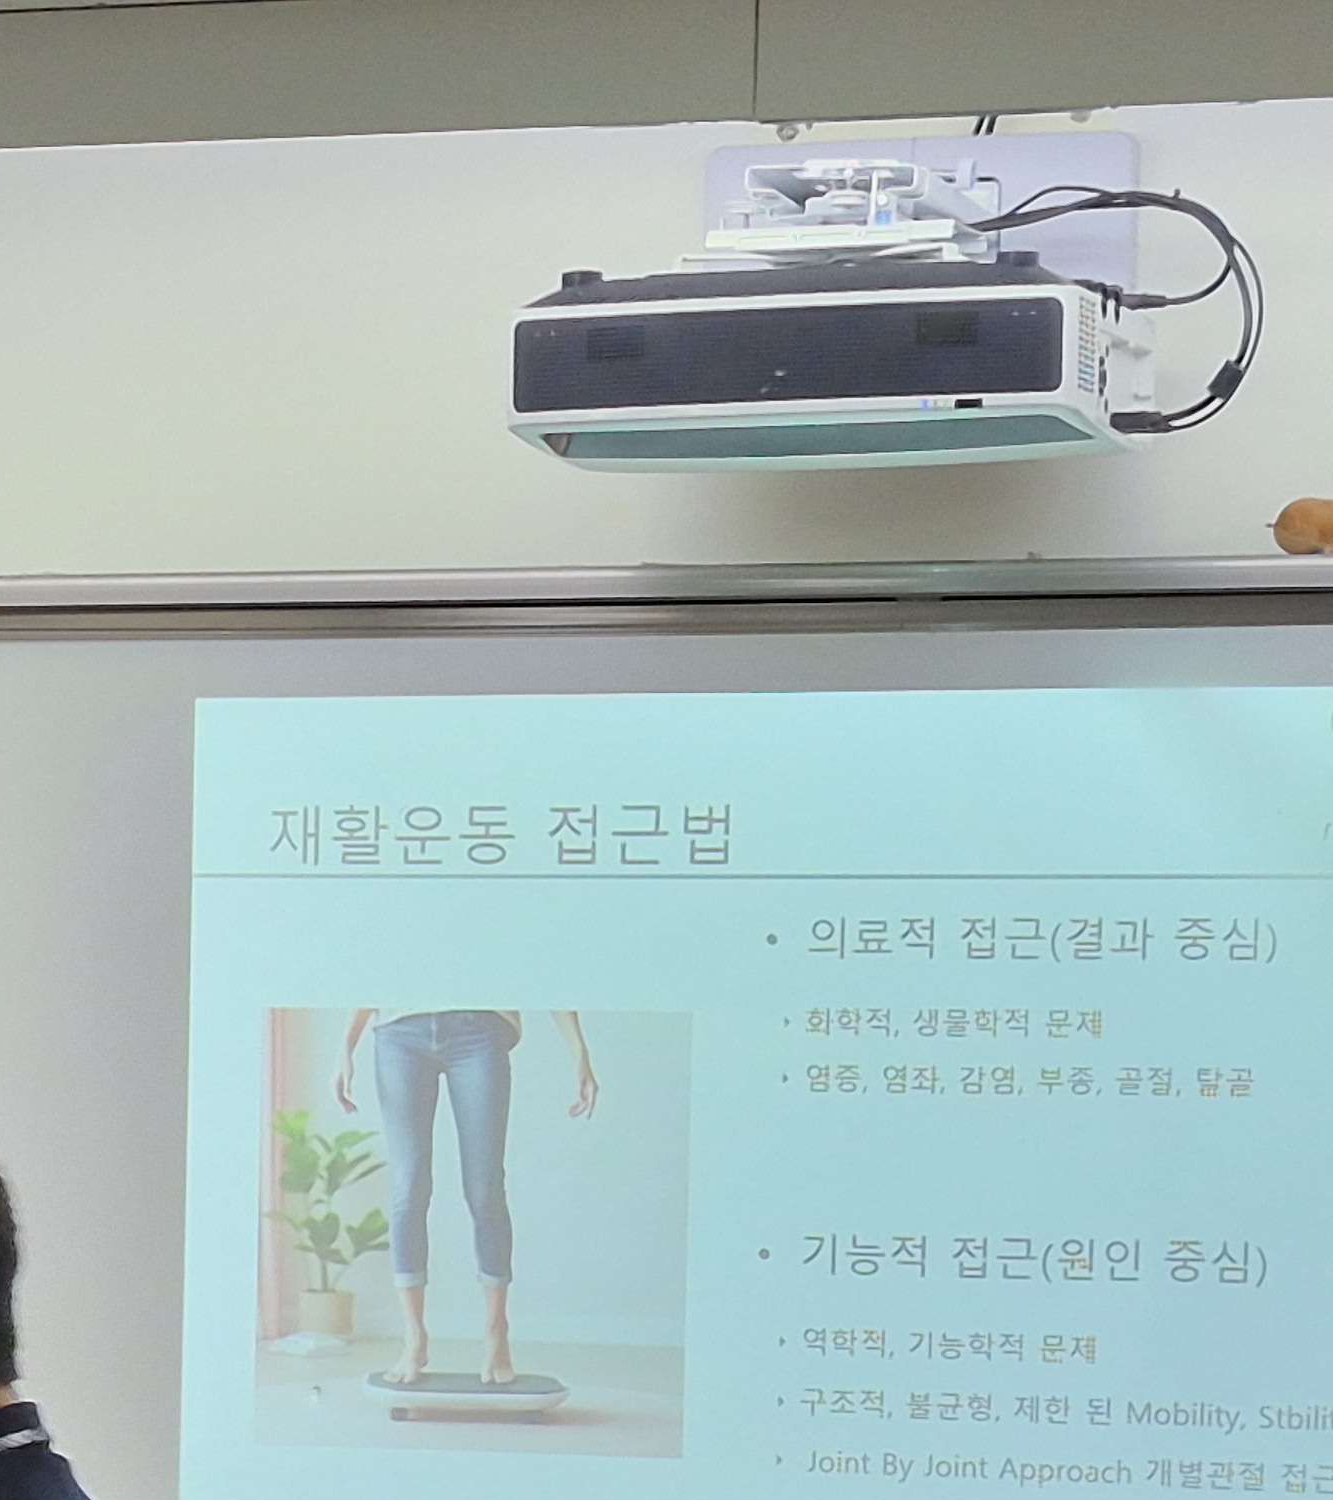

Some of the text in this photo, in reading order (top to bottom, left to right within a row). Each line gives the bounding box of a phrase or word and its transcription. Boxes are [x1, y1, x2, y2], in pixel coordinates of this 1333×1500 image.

[268, 803, 735, 868] 재활운동 접근법
[807, 917, 1278, 963] 의료적 접근(결과 중심)
[806, 1008, 1103, 1038] 화학적, 생물학적 문제
[806, 1065, 868, 1095] 염증,
[883, 1065, 945, 1095] 염좌,
[959, 1066, 1023, 1096] 감염,
[1036, 1066, 1101, 1096] 부종,
[1115, 1067, 1180, 1097] 골절,
[802, 1234, 1268, 1286] 기능적 접근(원인 중심)
[803, 1328, 1096, 1363] 역학적, 기능학적 문제
[800, 1388, 891, 1420] 구조적,
[907, 1392, 1000, 1423] 불균형,
[1014, 1396, 1070, 1424] 제한
[1086, 1398, 1112, 1426] 된
[1127, 1401, 1246, 1435] Mobility,
[807, 1450, 870, 1475] Joint
[883, 1453, 914, 1483] By
[924, 1454, 989, 1482] Joint
[999, 1455, 1131, 1488] Approach
[1146, 1459, 1266, 1491] 개별관절
